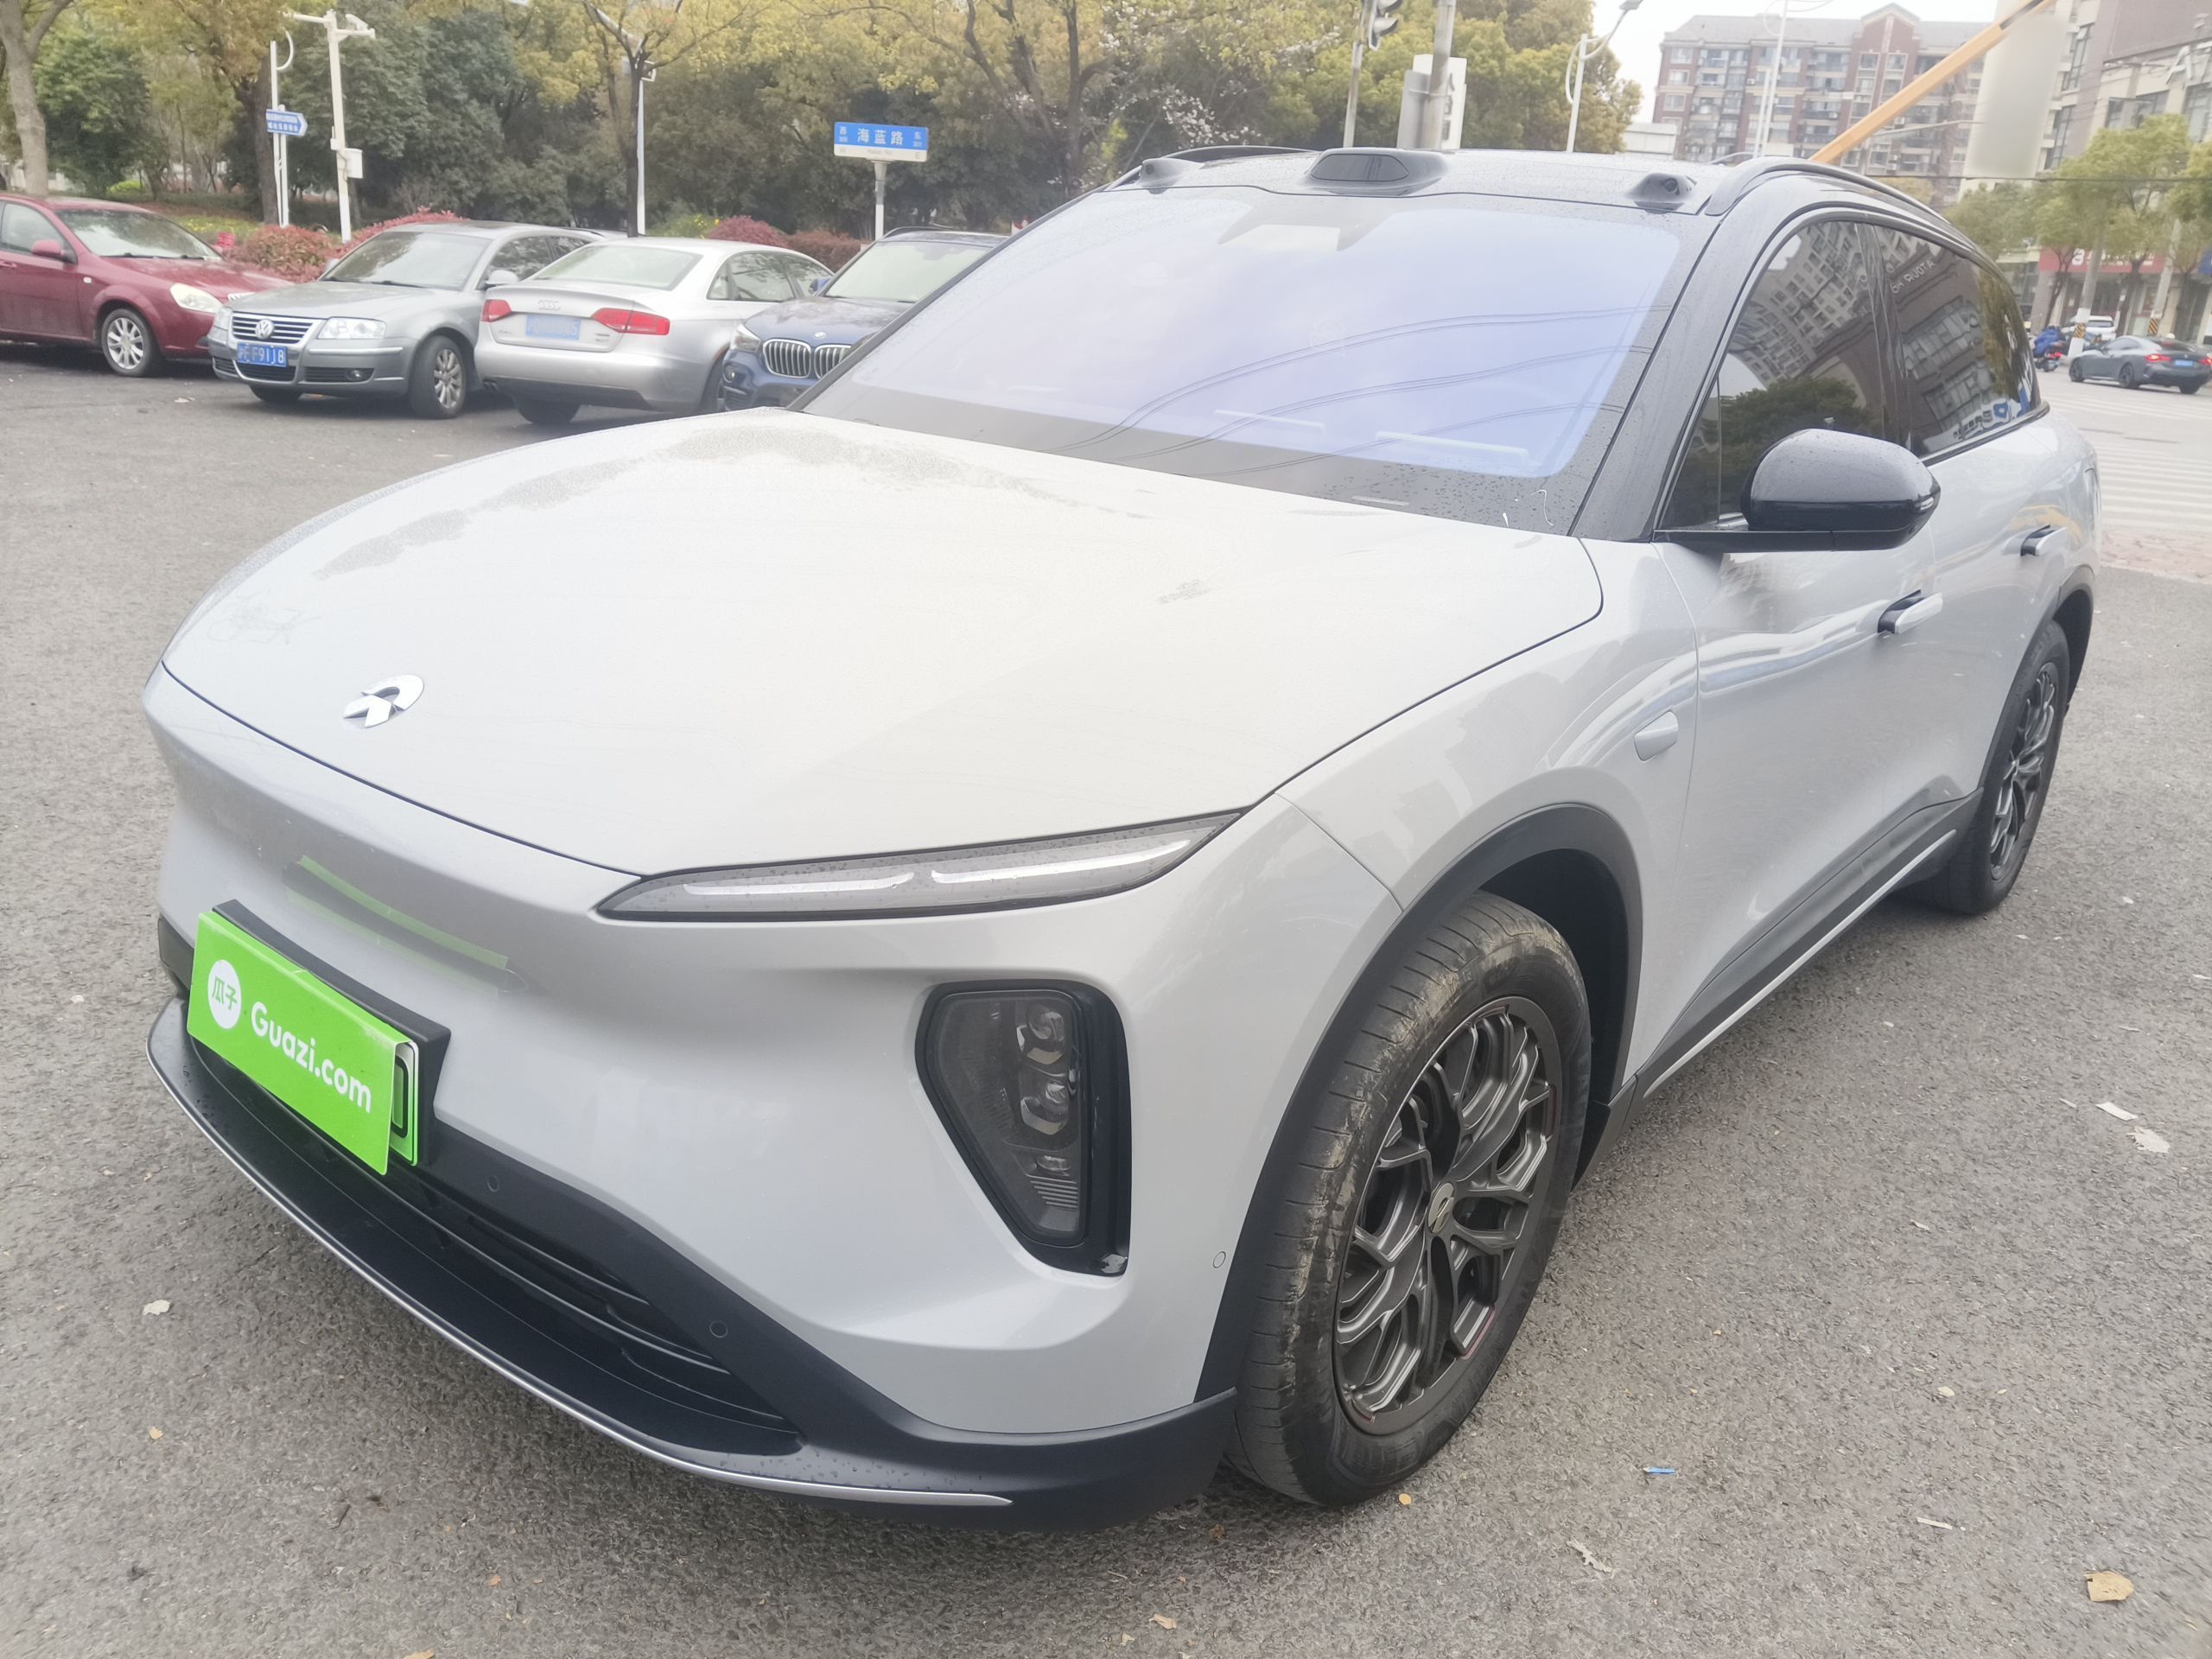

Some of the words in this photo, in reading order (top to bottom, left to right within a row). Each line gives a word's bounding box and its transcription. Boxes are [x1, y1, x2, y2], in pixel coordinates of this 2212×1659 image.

[857, 128, 903, 146] 海蓝路
[212, 975, 238, 1011] 瓜子
[251, 1001, 372, 1114] Guazi.com
